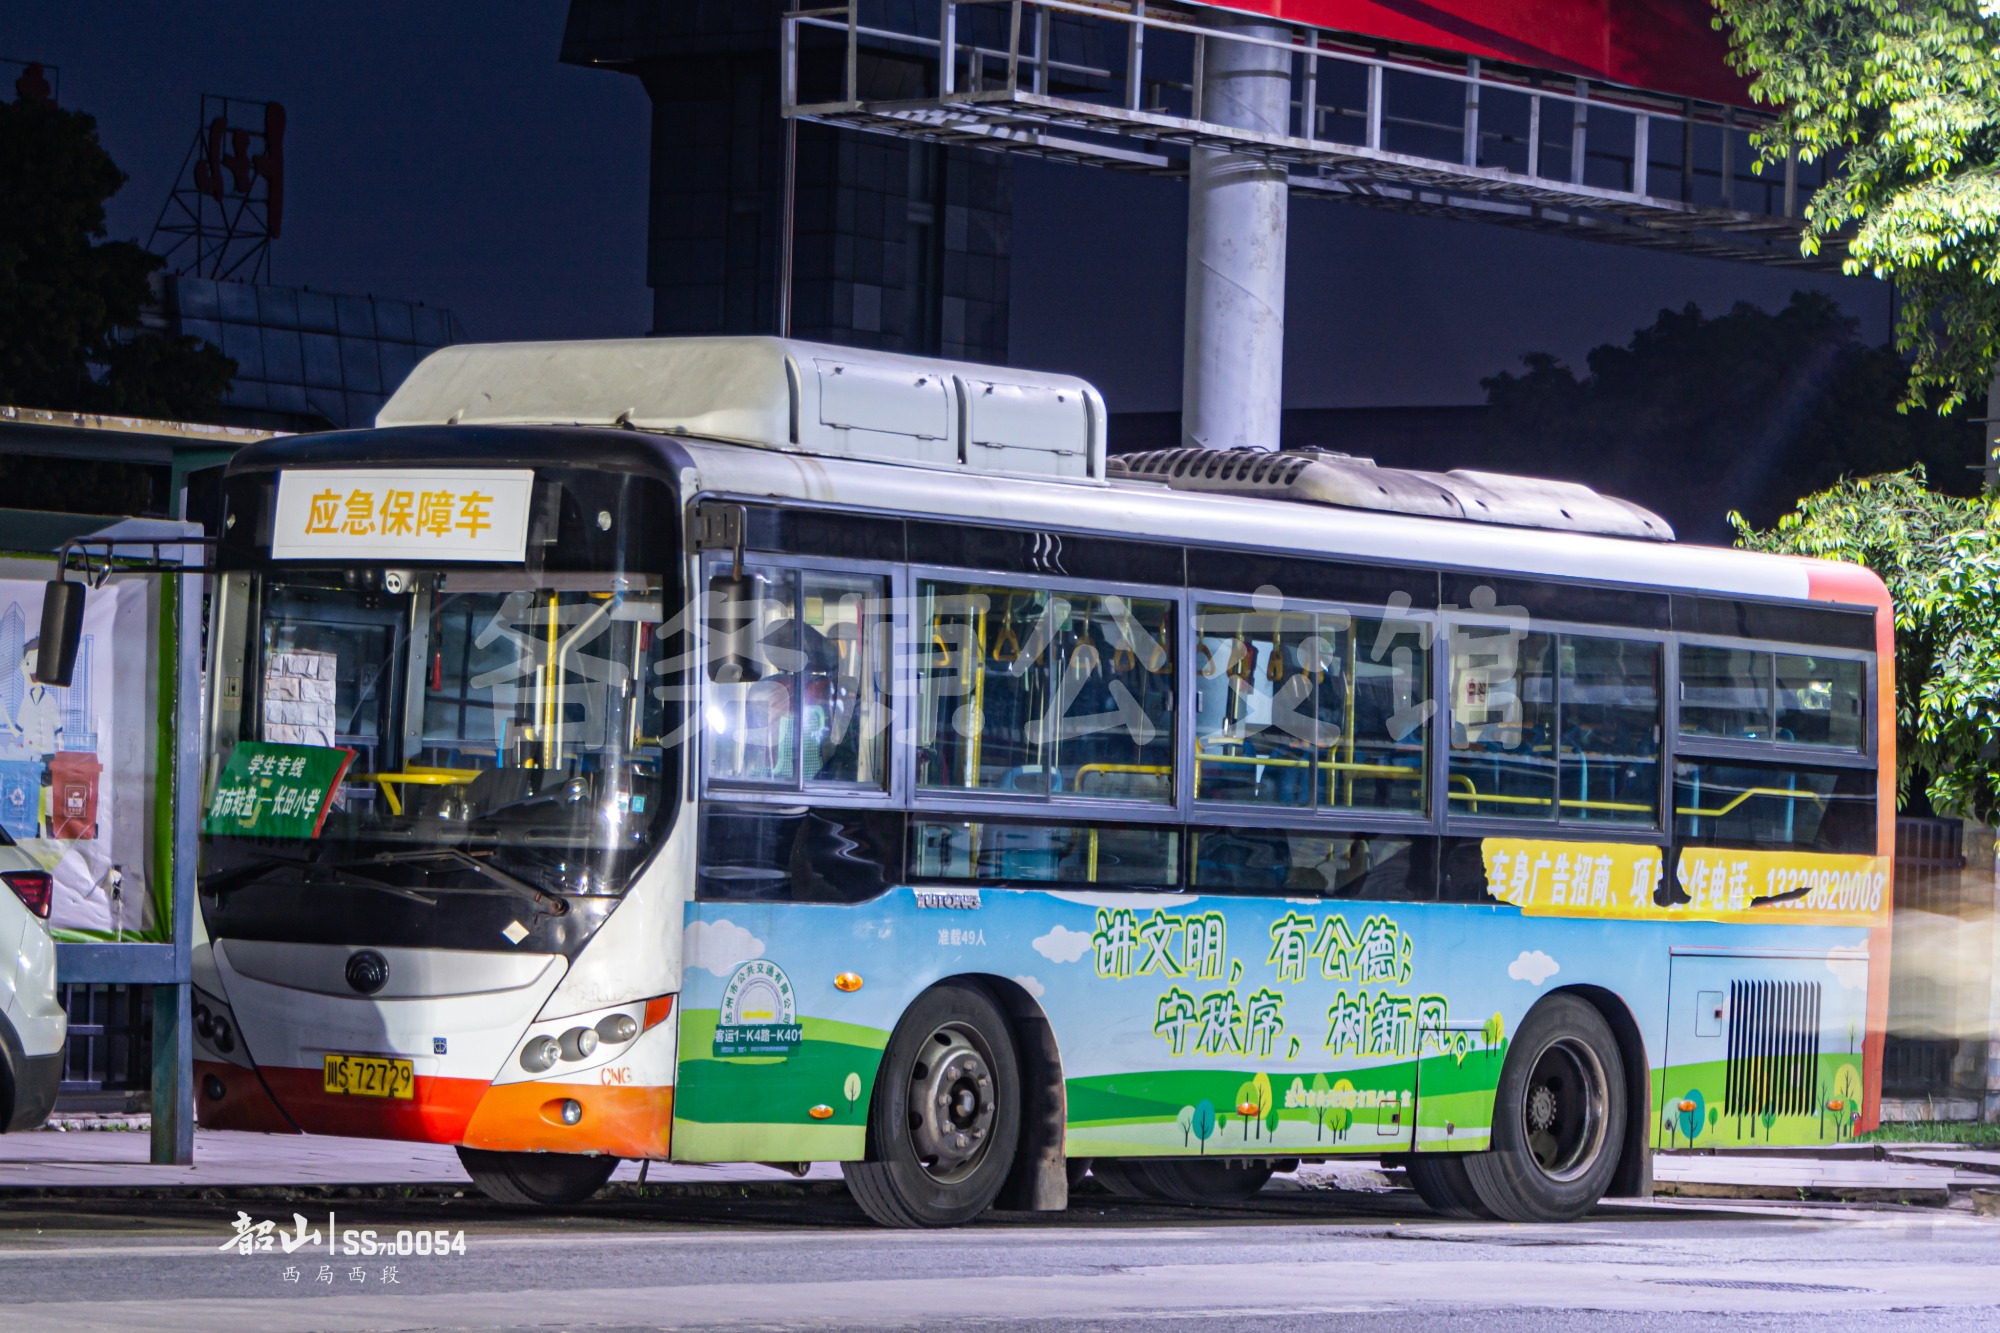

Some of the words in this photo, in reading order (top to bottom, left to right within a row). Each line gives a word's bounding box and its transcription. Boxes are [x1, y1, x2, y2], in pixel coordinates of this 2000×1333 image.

[305, 488, 494, 539] 应急保障车
[249, 755, 306, 778] 学生专线
[938, 928, 986, 946] 准载49人
[601, 1067, 632, 1086] CNG
